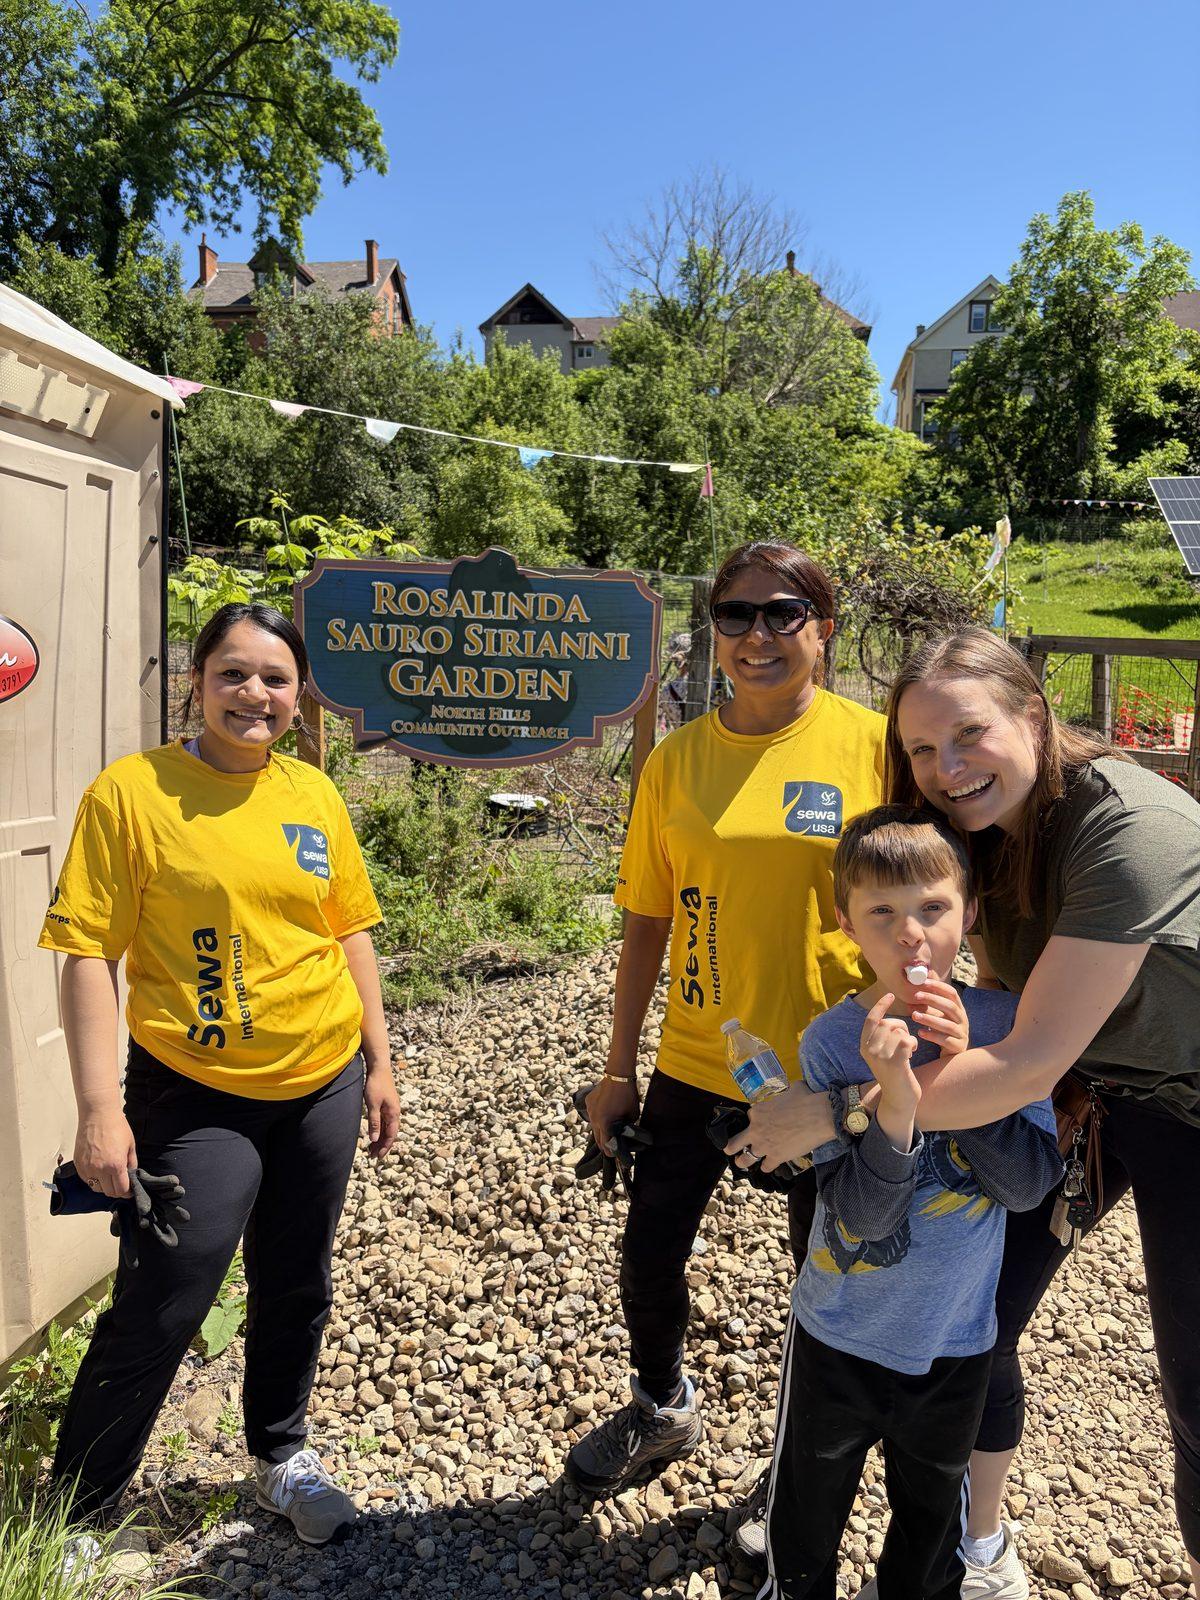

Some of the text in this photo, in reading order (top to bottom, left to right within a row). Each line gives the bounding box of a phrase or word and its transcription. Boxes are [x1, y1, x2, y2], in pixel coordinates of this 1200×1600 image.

[372, 581, 591, 623] ROSALINDA
[327, 618, 631, 661] SAURO SIRIANNI
[0, 671, 22, 693] 3791
[389, 659, 572, 702] GARDEN
[431, 704, 531, 722] NORTH HILLS
[391, 719, 570, 740] COMMUNITY OUTREACH
[796, 809, 837, 821] sewa
[811, 823, 836, 835] usa
[302, 850, 328, 864] sewa
[316, 865, 328, 876] usa
[679, 886, 705, 1010] Sewa
[705, 895, 721, 1006] International
[186, 927, 226, 1050] Sewa
[228, 933, 254, 1041] International
